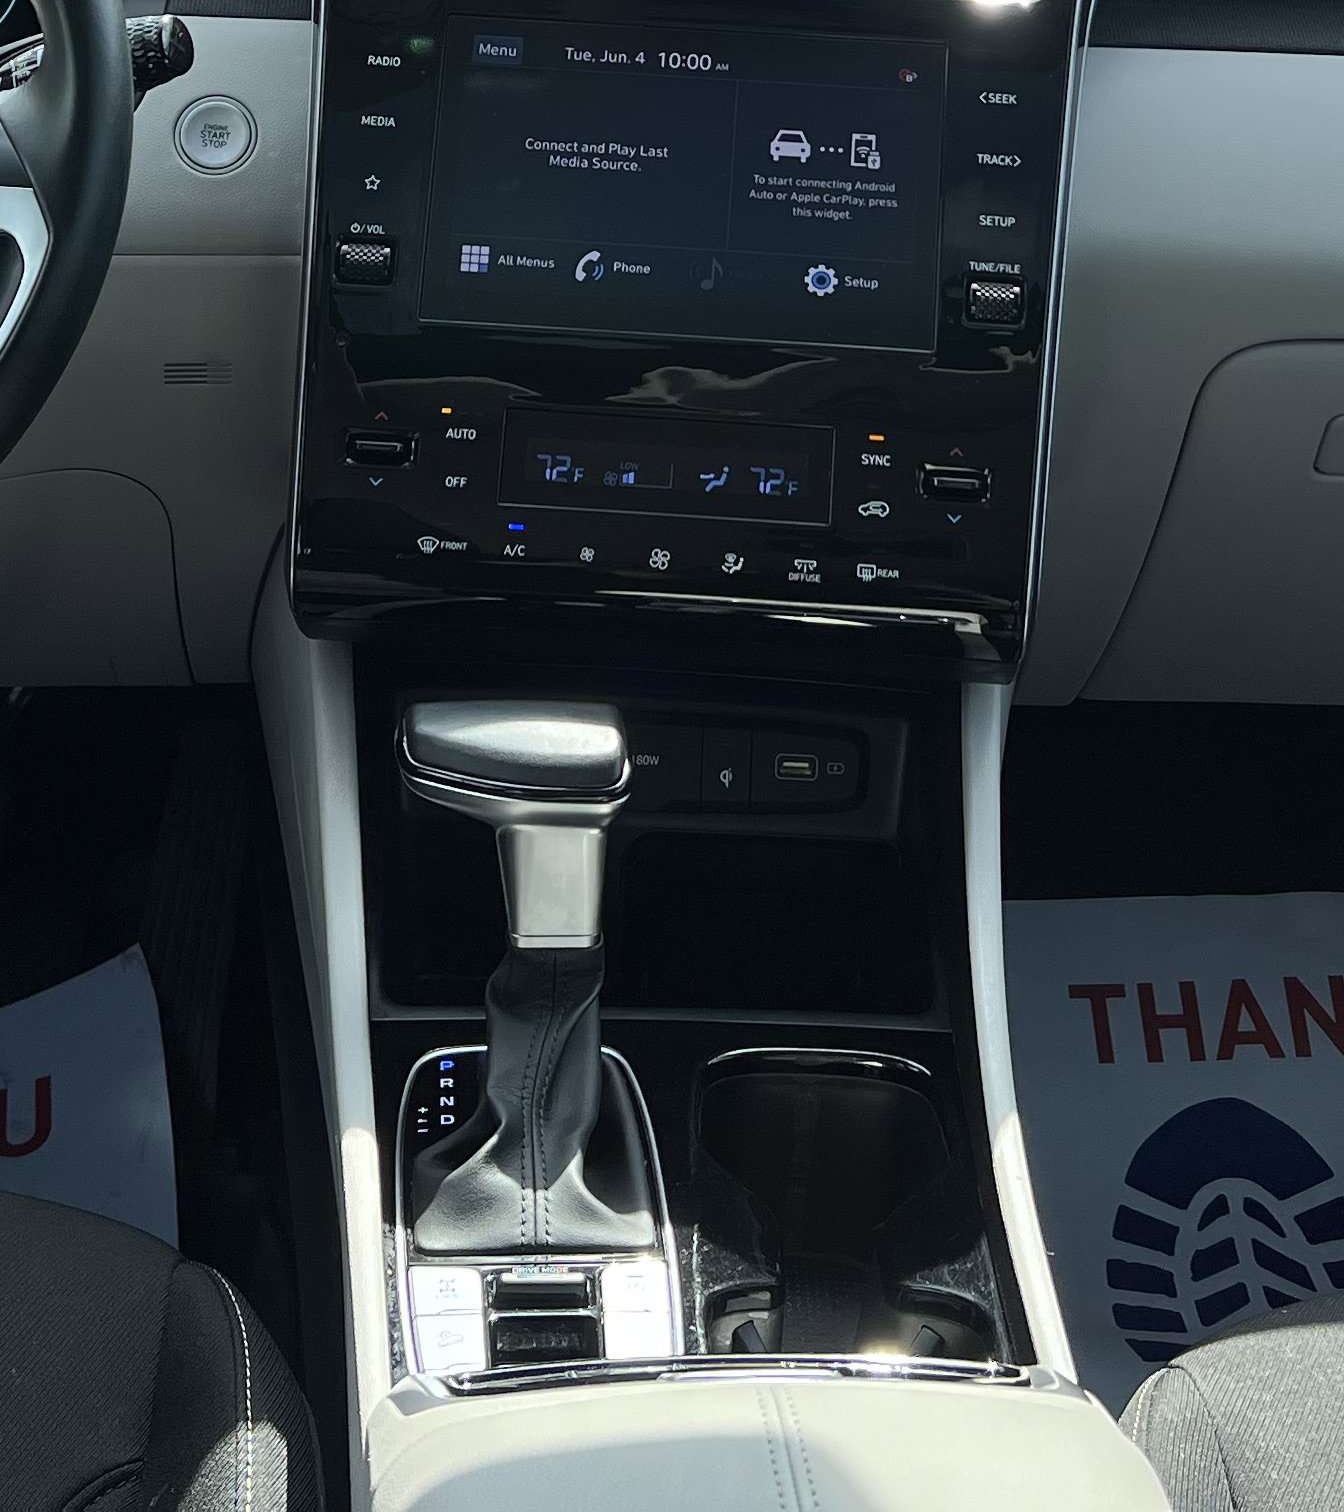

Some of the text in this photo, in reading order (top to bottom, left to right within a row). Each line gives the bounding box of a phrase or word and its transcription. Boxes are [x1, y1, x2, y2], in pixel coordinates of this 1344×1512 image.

[478, 42, 517, 58] Menu
[367, 54, 401, 67] RADIO
[600, 49, 632, 65] Jun.
[633, 51, 646, 65] 4
[657, 51, 712, 71] 10:00
[715, 63, 729, 71] AM
[987, 92, 1018, 105] SEEK
[203, 123, 228, 131] ENGINE
[361, 115, 396, 128] MEDIA
[200, 129, 231, 140] START
[201, 139, 227, 149] STOP
[525, 138, 668, 158] Connect and Play Last
[549, 155, 642, 172] Media Source.
[976, 153, 1013, 166] TRACK
[753, 174, 896, 193] To start connecting Android
[748, 189, 774, 200] Auto
[776, 192, 787, 201] or
[790, 192, 821, 204] Apple
[868, 198, 898, 208] press
[792, 206, 852, 221] this widget.
[979, 214, 1016, 227] SETUP
[497, 254, 556, 269] All Menus
[613, 261, 651, 274] Phone
[968, 261, 1021, 274] TUNE/FILE
[844, 276, 879, 290] Setup
[445, 428, 477, 440] AUTO
[619, 462, 639, 471] LOW
[861, 453, 892, 467] SYNC
[445, 476, 468, 488] OFF
[440, 540, 468, 551] FRONT
[503, 544, 526, 557] A/C
[788, 572, 821, 584] DIFFUSE
[876, 568, 899, 579] REAR
[439, 1060, 454, 1071] P
[439, 1078, 454, 1089] R
[439, 1096, 454, 1107] N
[440, 1114, 455, 1125] D
